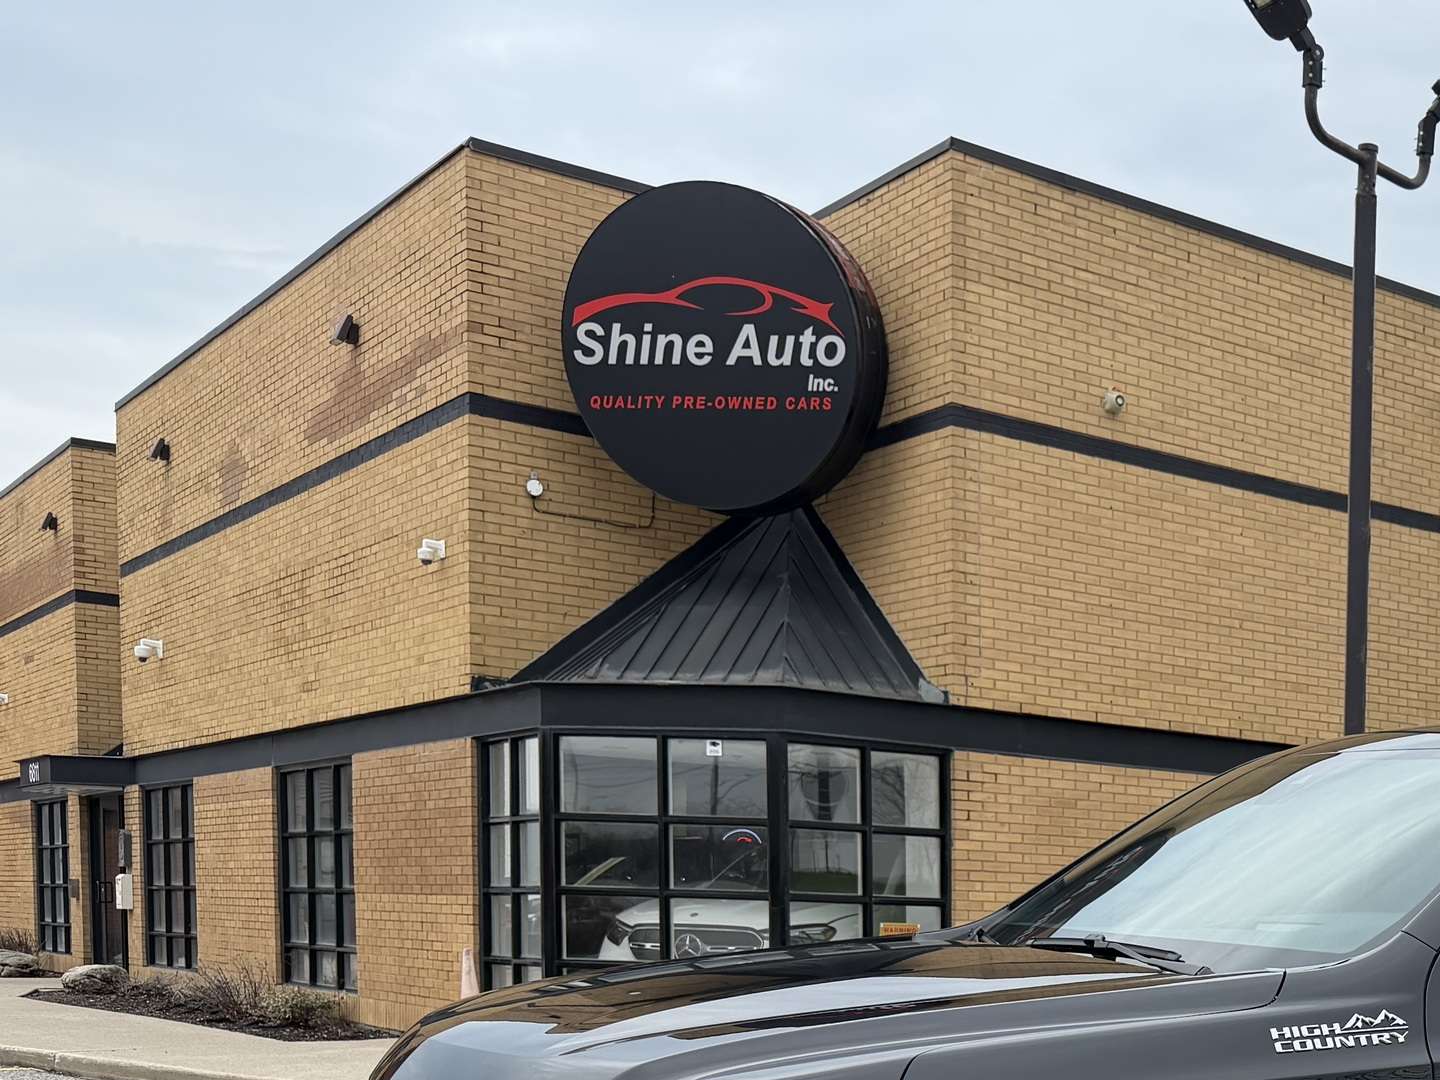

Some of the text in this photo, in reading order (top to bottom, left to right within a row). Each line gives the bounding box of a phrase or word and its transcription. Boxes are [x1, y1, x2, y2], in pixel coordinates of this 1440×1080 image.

[573, 322, 846, 367] Shine Auto
[808, 374, 839, 392] Inc.
[590, 395, 832, 410] QUALITY PRE-OWNED CARS
[1270, 1023, 1341, 1040] HIGH
[1274, 1031, 1408, 1053] COUNTRY
